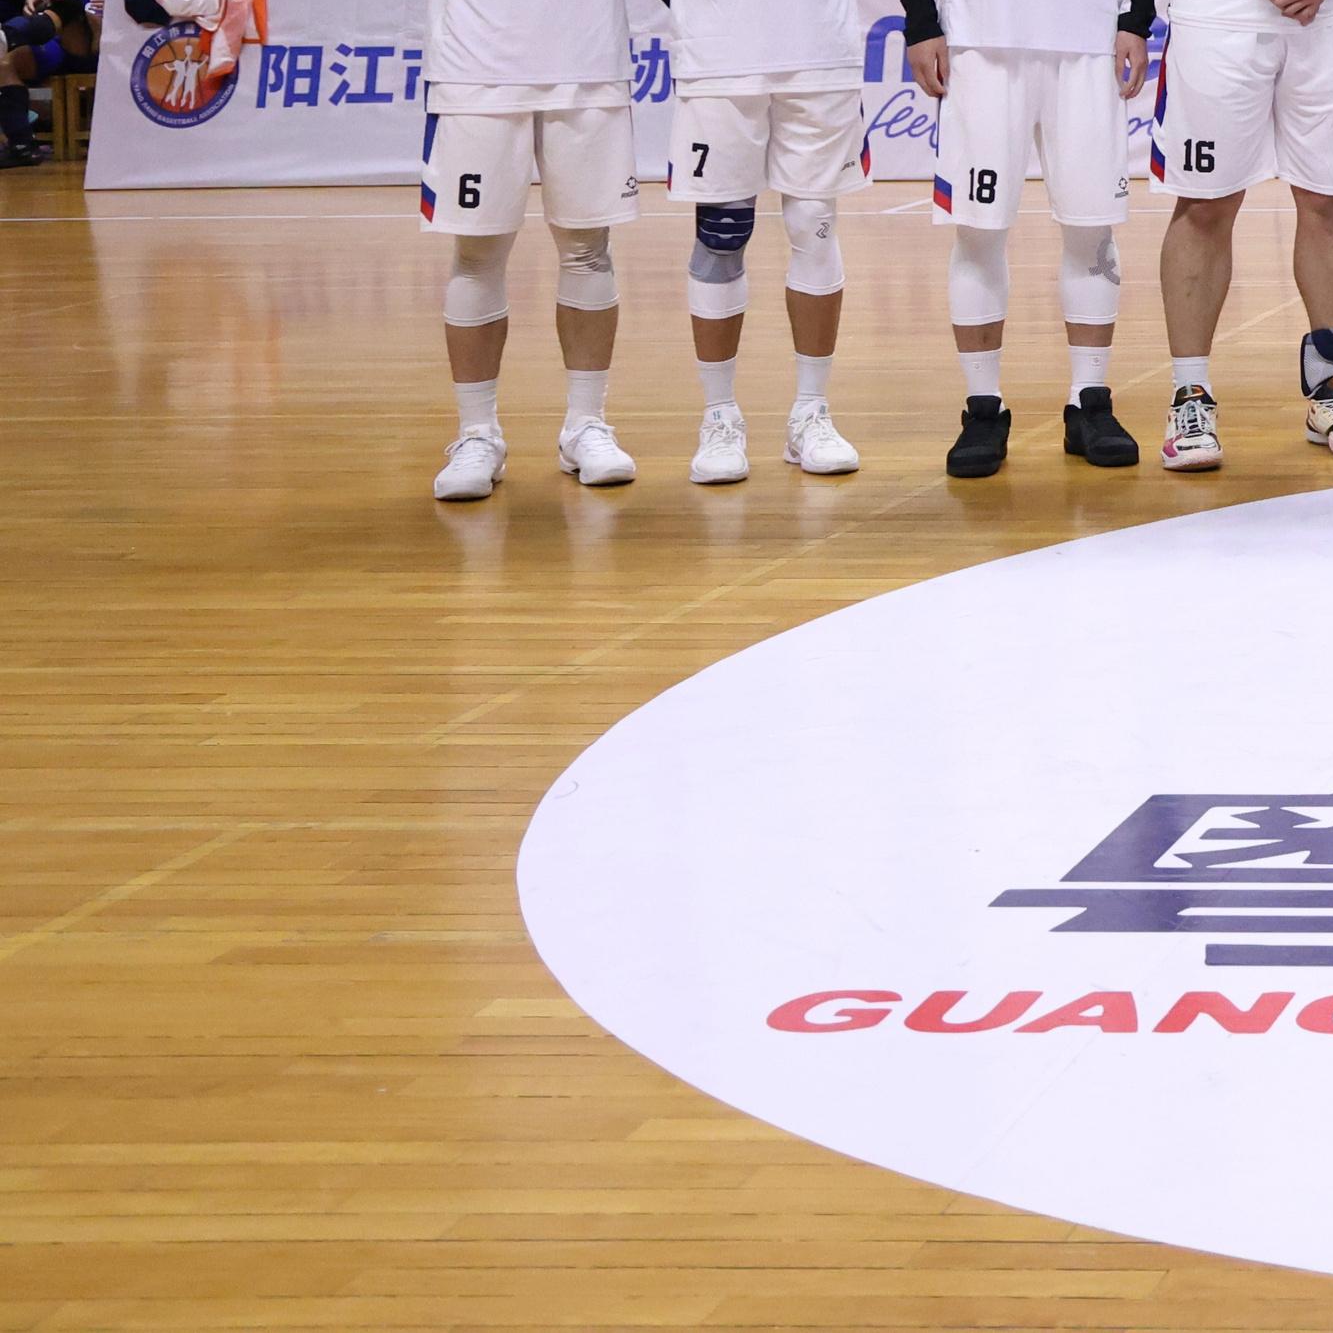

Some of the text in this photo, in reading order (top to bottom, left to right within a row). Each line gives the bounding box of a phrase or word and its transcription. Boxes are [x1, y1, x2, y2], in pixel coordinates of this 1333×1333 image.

[692, 142, 709, 177] 7
[1183, 138, 1215, 173] 16
[458, 173, 481, 209] 6
[969, 167, 997, 203] 18
